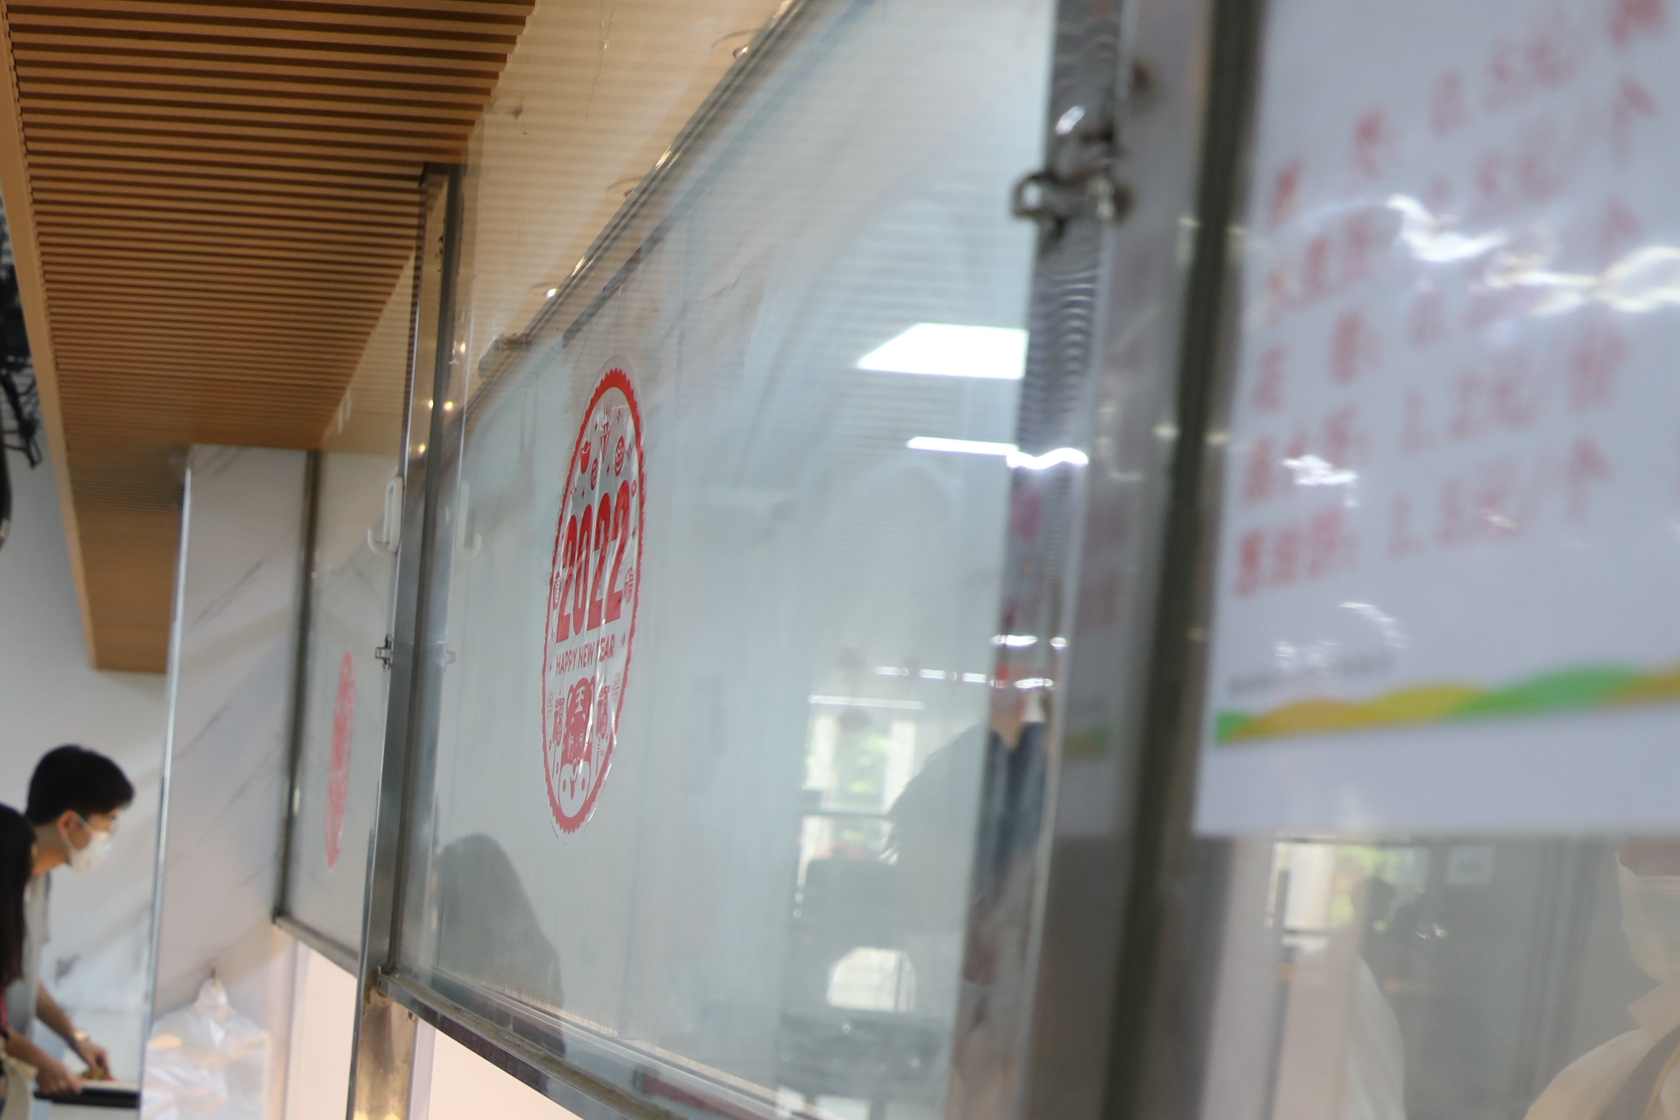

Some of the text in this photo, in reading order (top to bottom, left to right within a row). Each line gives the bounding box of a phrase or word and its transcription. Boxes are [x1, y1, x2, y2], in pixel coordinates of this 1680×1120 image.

[556, 480, 630, 643] 2022
[555, 634, 616, 676] HAPPY NEW EAR
